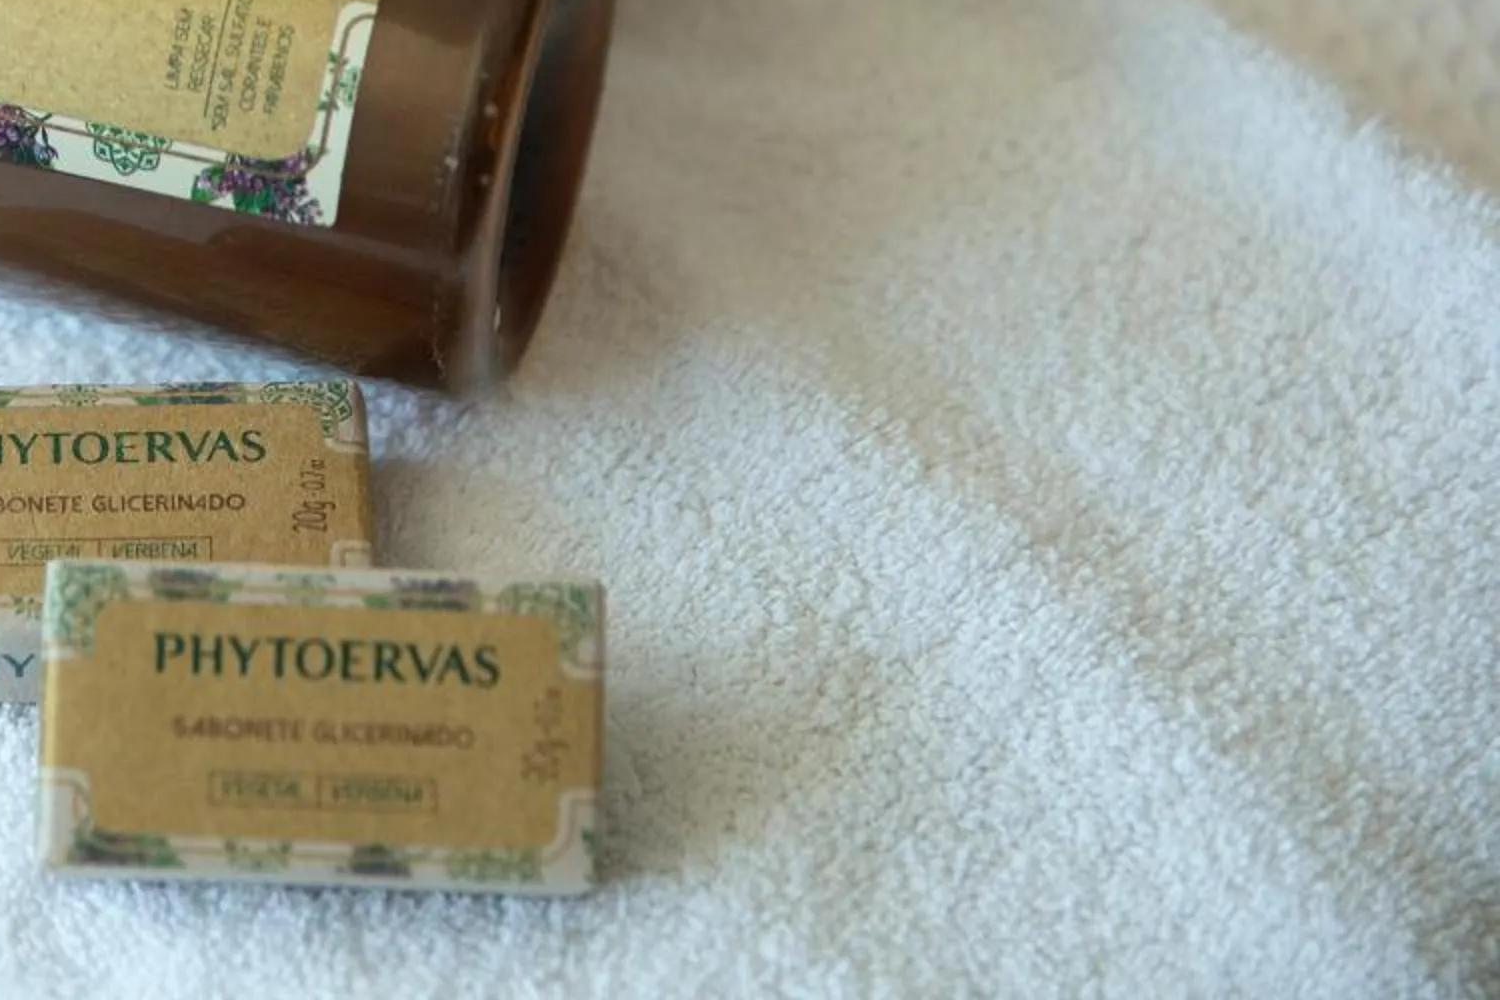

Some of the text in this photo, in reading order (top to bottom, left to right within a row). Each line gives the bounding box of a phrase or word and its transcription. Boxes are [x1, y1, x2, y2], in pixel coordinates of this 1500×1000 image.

[187, 14, 215, 93] RESSECAR
[91, 493, 246, 514] GLICERINADO
[111, 542, 197, 560] VERBENA
[154, 631, 501, 690] PHYTOERVAS
[171, 714, 476, 751] SABONETE GLICERINADO
